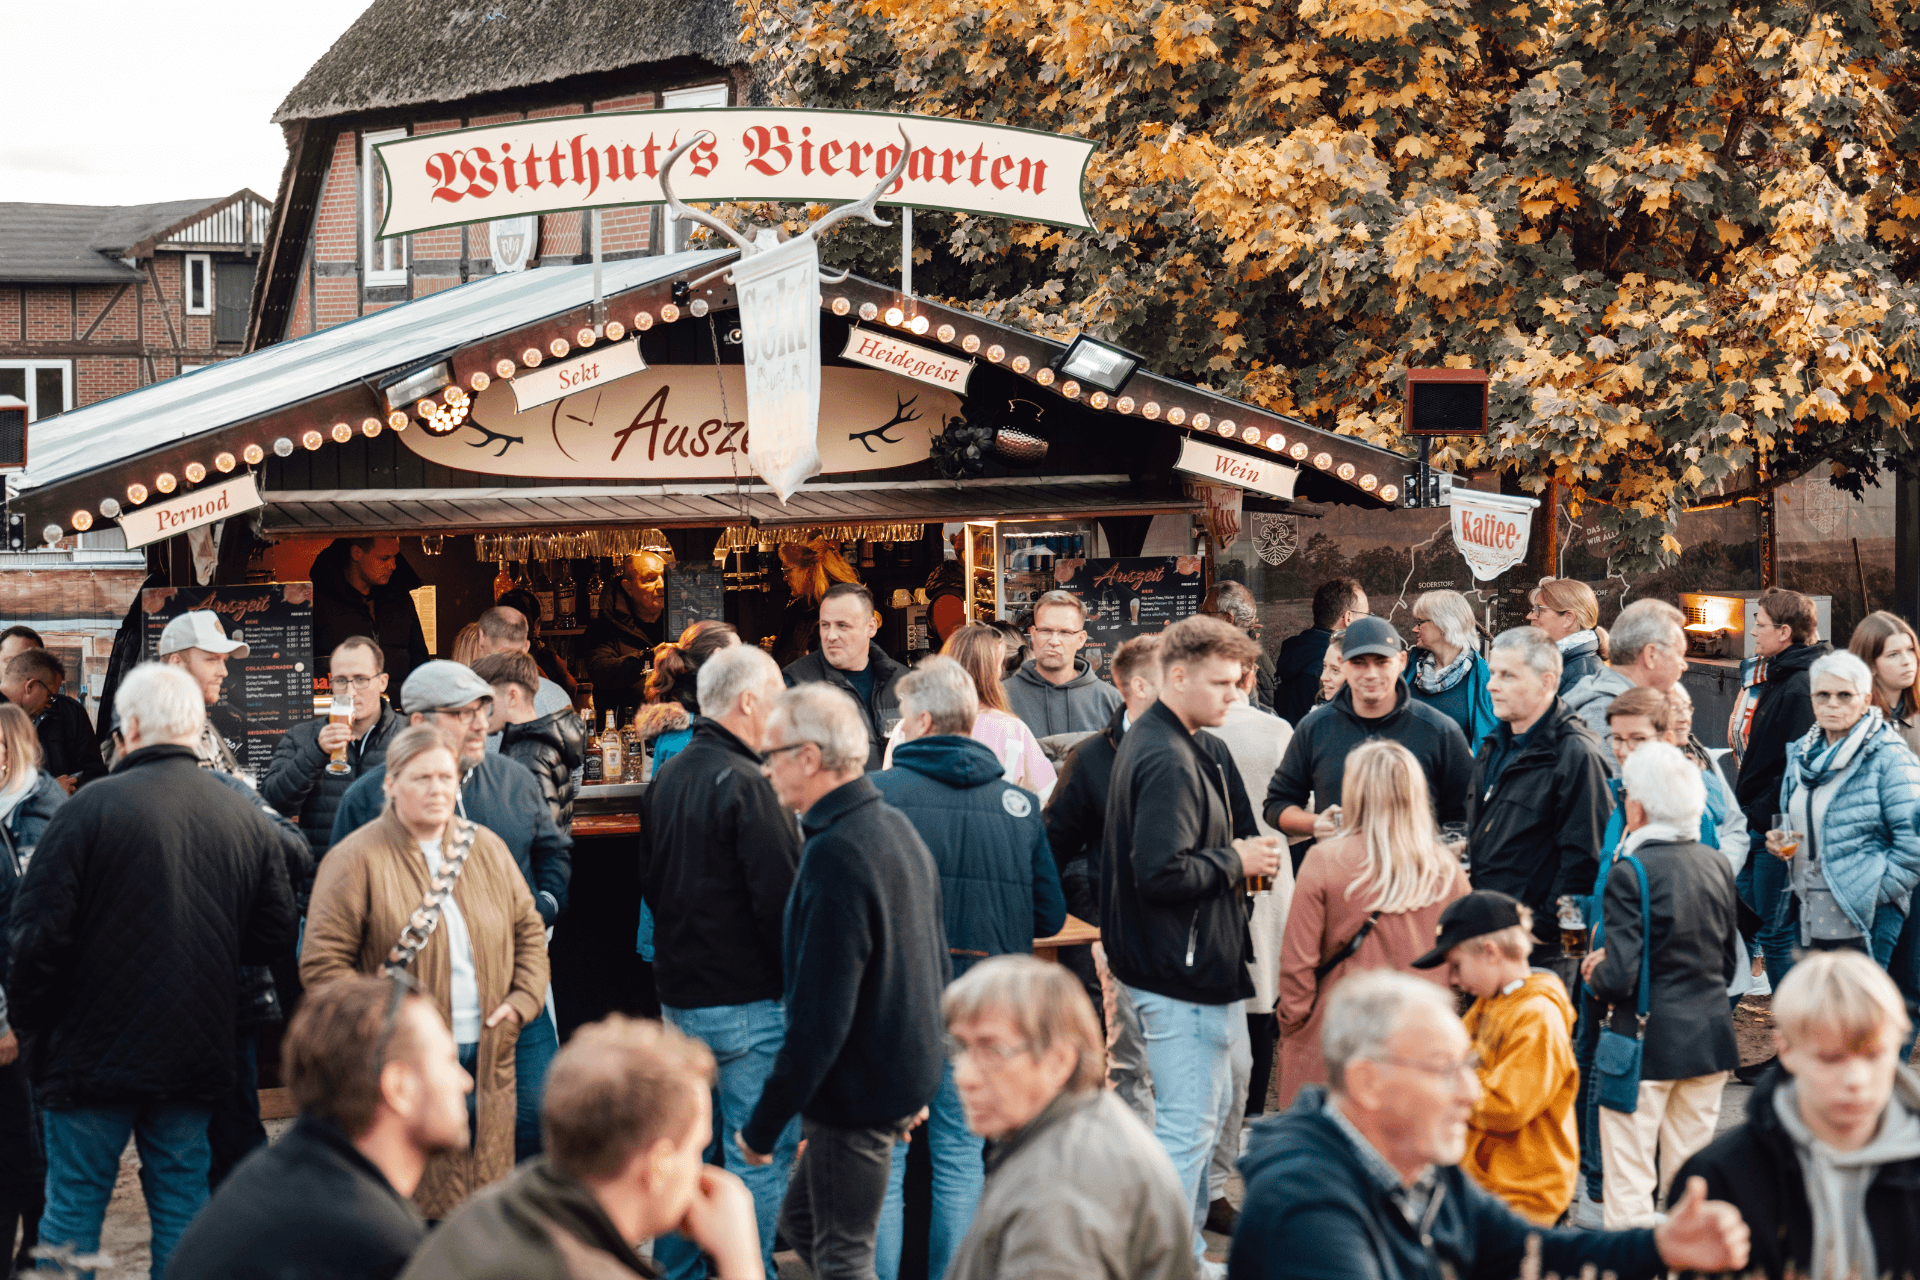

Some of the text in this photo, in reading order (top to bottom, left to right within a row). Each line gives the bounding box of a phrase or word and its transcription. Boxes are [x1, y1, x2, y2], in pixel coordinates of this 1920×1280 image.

[425, 125, 1048, 203] Witthut's Biergarten
[559, 362, 601, 390] Sekt
[856, 336, 960, 384] Heidegeist
[611, 385, 749, 461] Ausz
[1214, 455, 1260, 483] Wein
[156, 489, 230, 532] Pernod
[1461, 510, 1521, 550] Kaffee-
[1586, 525, 1601, 535] DAS
[1587, 536, 1602, 545] WIR
[1093, 561, 1165, 591] Auszeit
[187, 590, 271, 622] Auszeit
